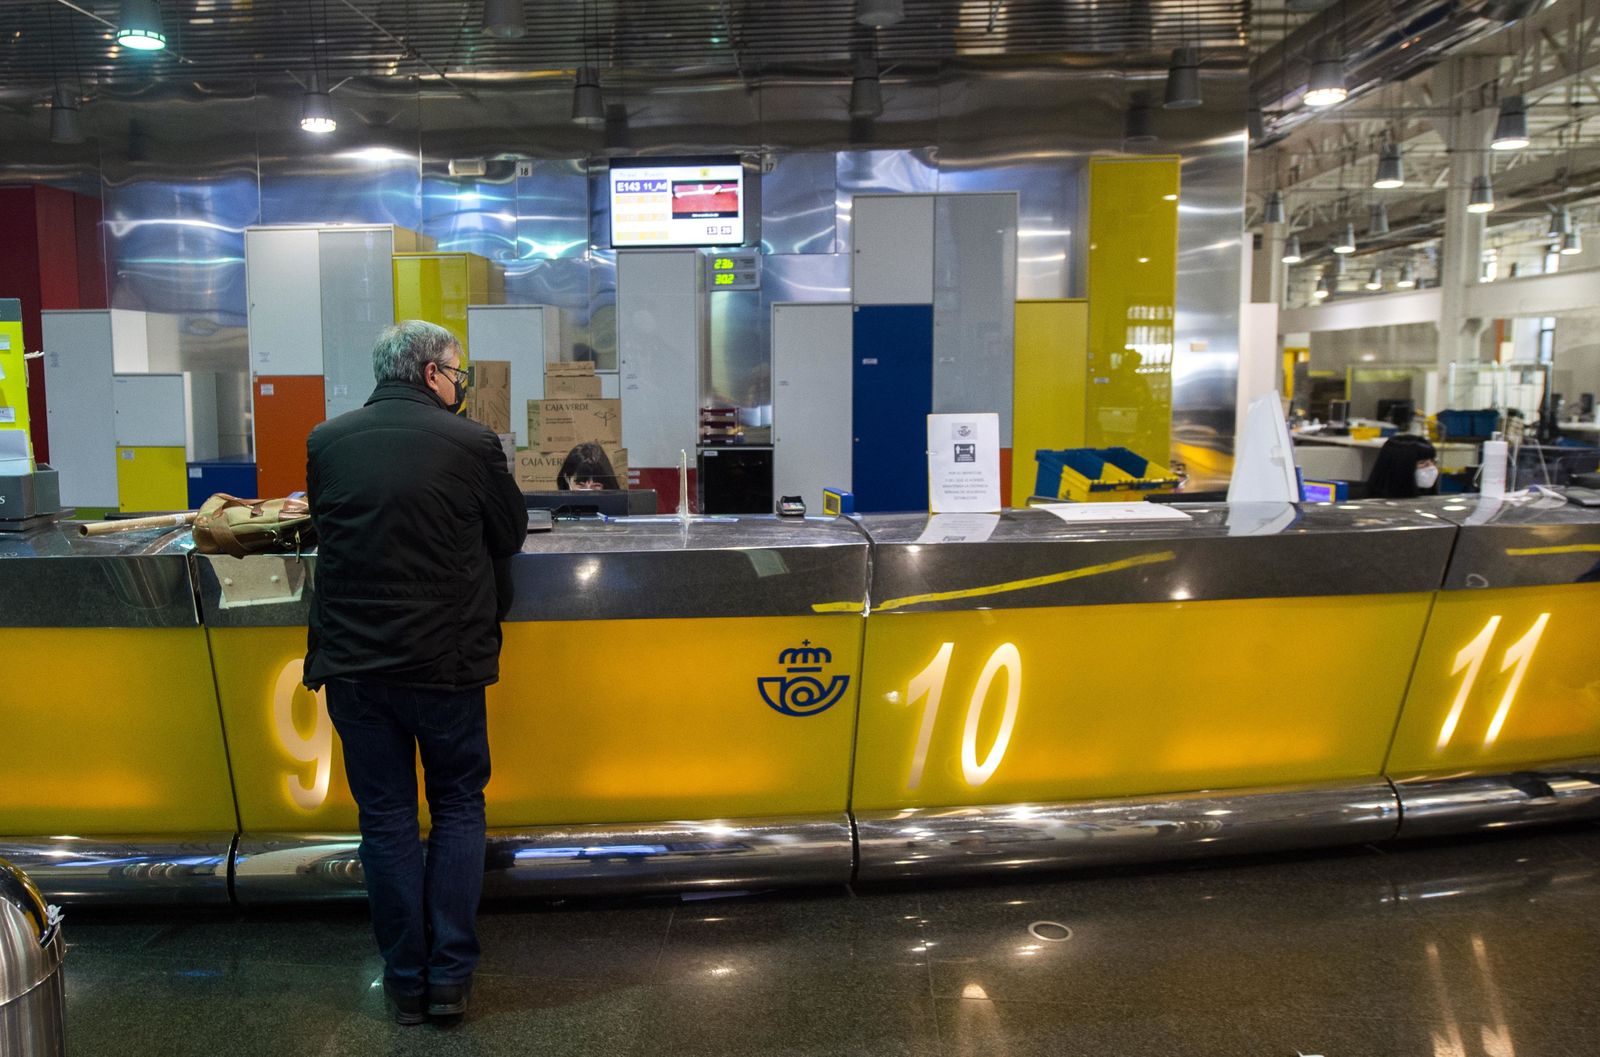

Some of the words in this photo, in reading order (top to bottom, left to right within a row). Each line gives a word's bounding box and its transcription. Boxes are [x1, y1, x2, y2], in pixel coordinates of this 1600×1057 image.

[616, 181, 641, 192] E143
[545, 403, 564, 412] CAJA
[565, 402, 589, 411] VERDE
[521, 457, 544, 467] CAJA
[905, 641, 1023, 790] 10
[1436, 612, 1551, 752] 11
[274, 657, 332, 811] 9
